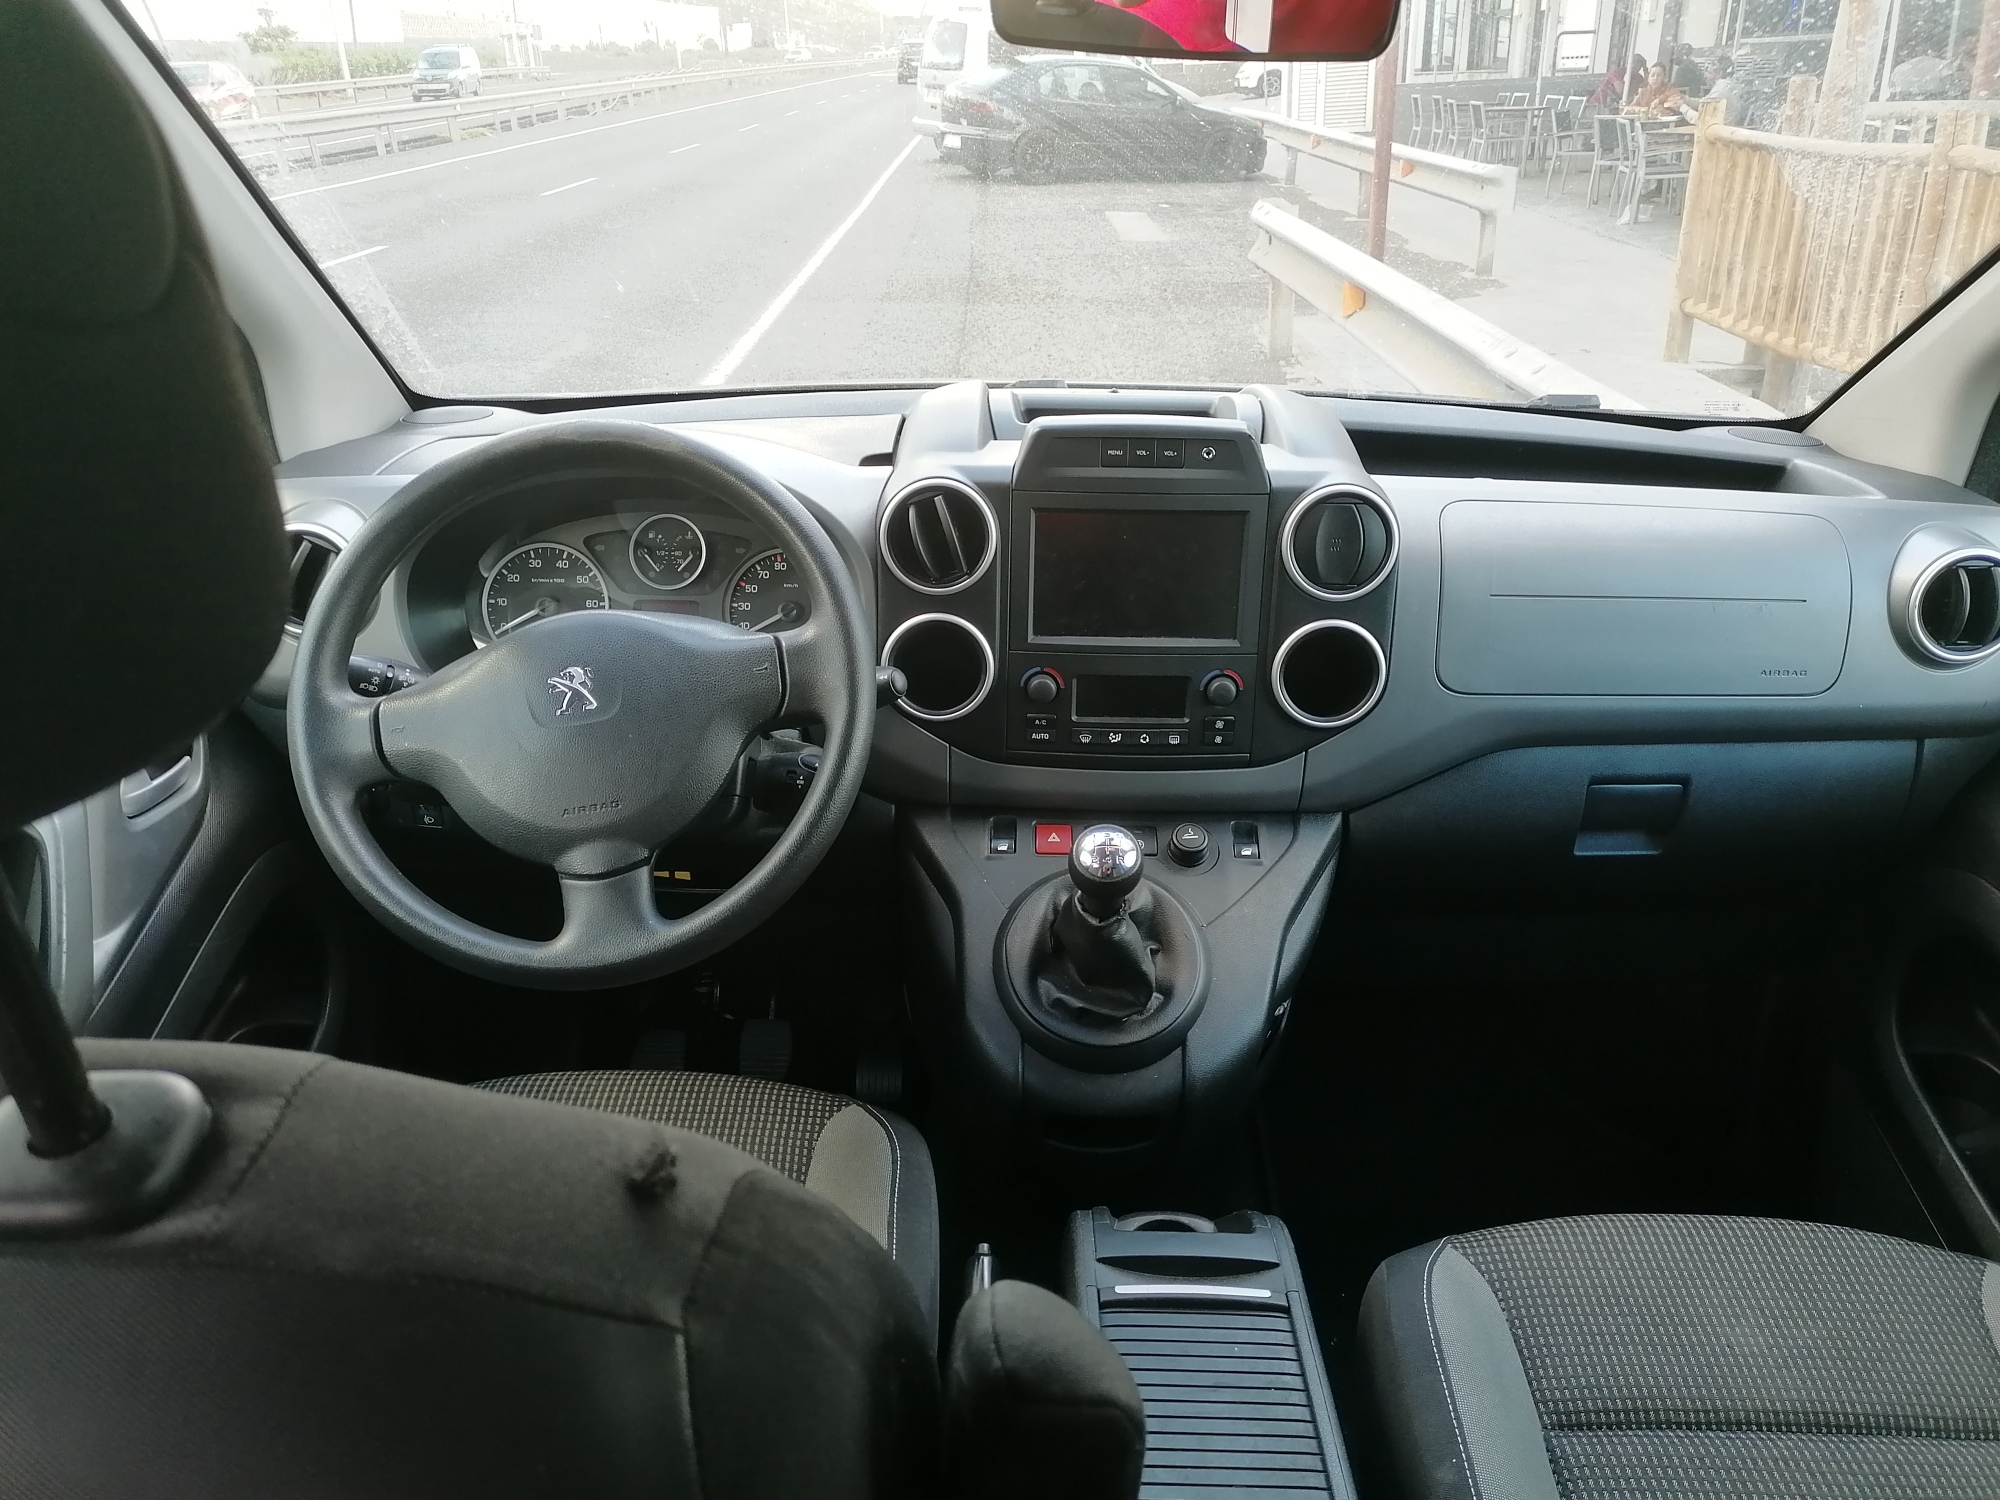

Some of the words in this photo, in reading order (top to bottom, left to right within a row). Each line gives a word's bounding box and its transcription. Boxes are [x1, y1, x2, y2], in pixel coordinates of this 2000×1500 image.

[528, 559, 542, 568] 30
[555, 560, 569, 569] 40
[774, 562, 787, 571] 90
[507, 574, 520, 582] 20
[757, 570, 770, 579] 70
[576, 575, 589, 584] 50
[745, 584, 758, 593] 50
[737, 602, 751, 611] 30
[739, 621, 750, 630] 10
[1760, 669, 1808, 677] AIRBAG
[561, 800, 621, 817] AIRBAG
